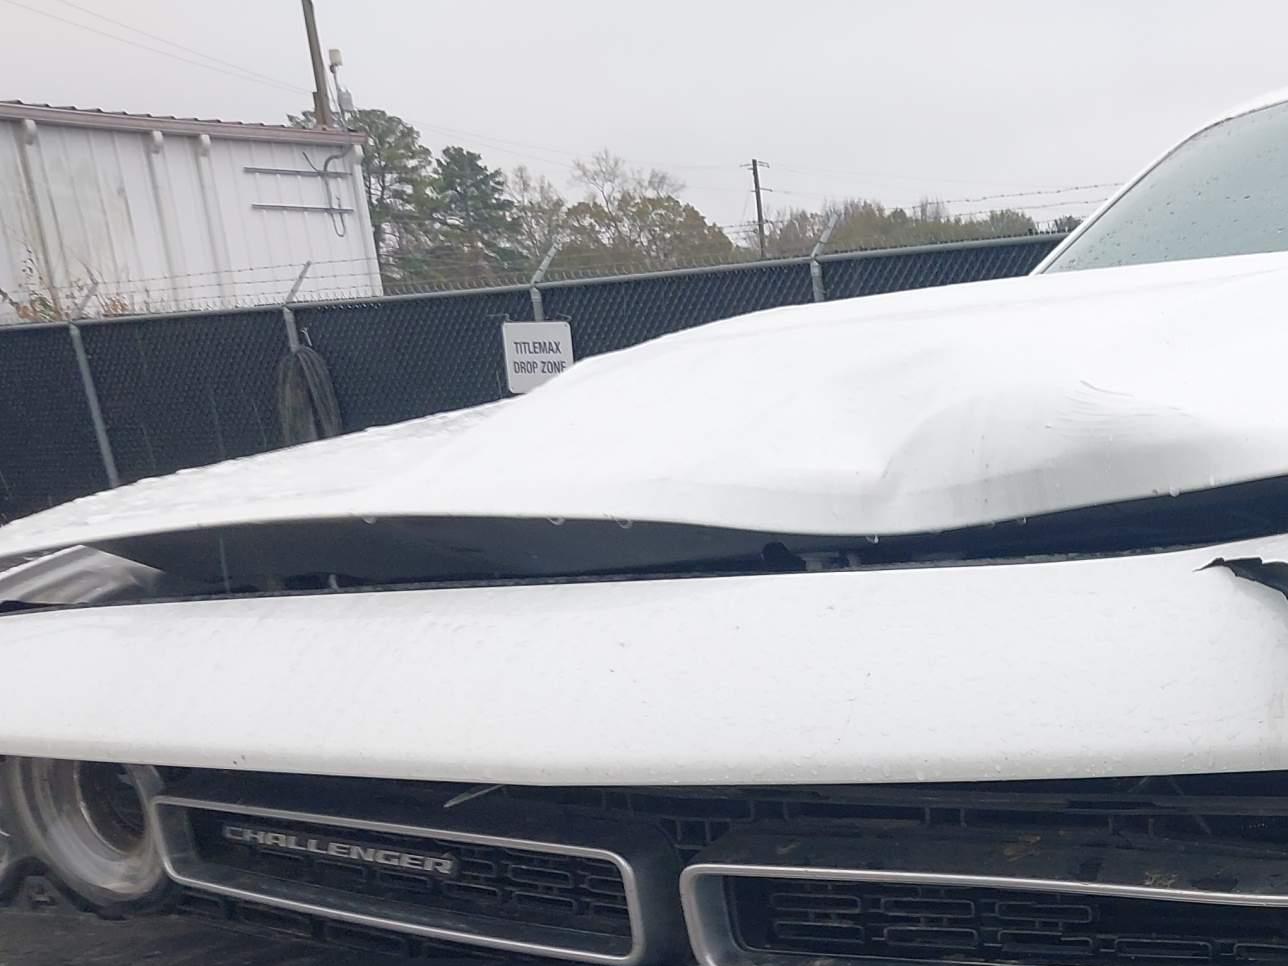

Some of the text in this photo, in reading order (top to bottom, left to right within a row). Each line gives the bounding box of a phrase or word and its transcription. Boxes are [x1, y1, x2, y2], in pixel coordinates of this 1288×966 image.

[513, 341, 562, 355] TITLEMAX
[513, 360, 538, 374] DROP
[223, 825, 455, 875] CHALLENGER
